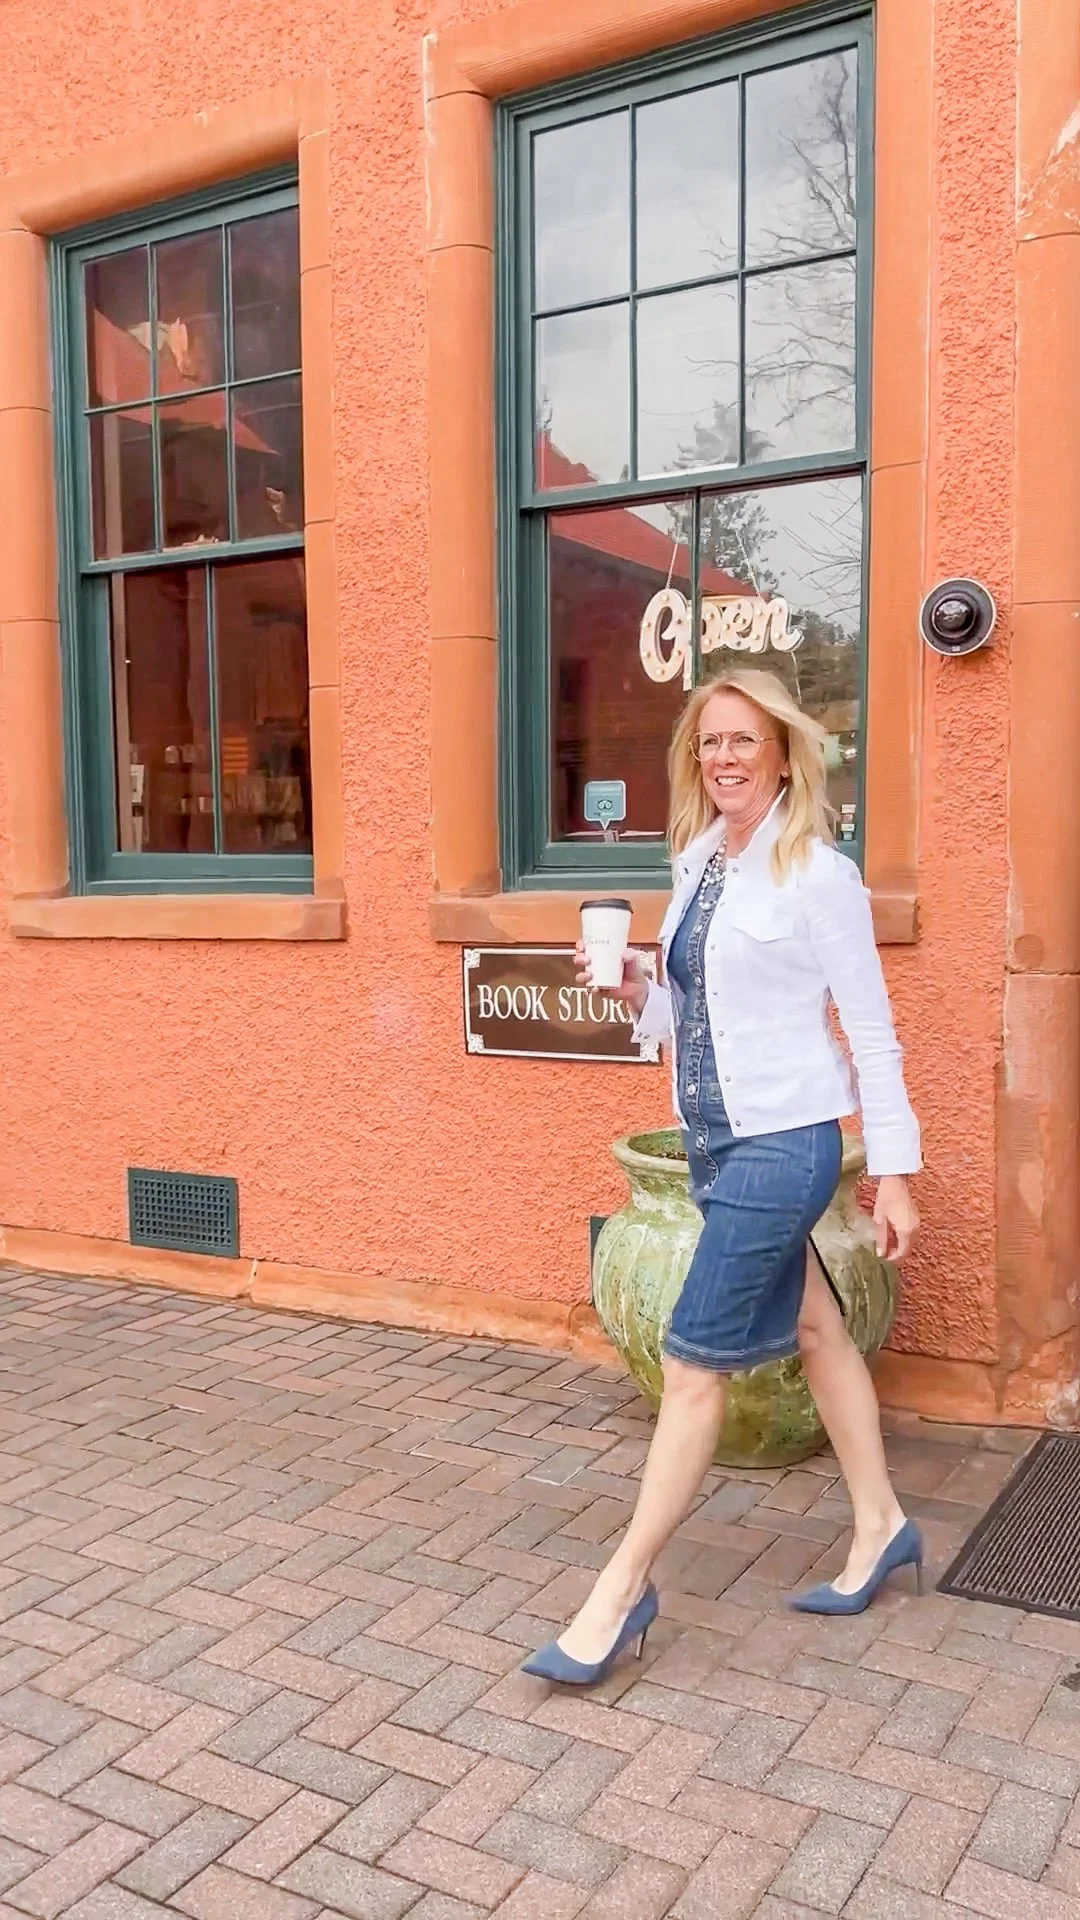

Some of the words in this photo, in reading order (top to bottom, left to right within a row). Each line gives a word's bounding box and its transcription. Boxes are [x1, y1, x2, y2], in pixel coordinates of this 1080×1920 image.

[639, 588, 804, 691] Open
[477, 984, 550, 1021] BOOK
[558, 986, 634, 1023] STOR
